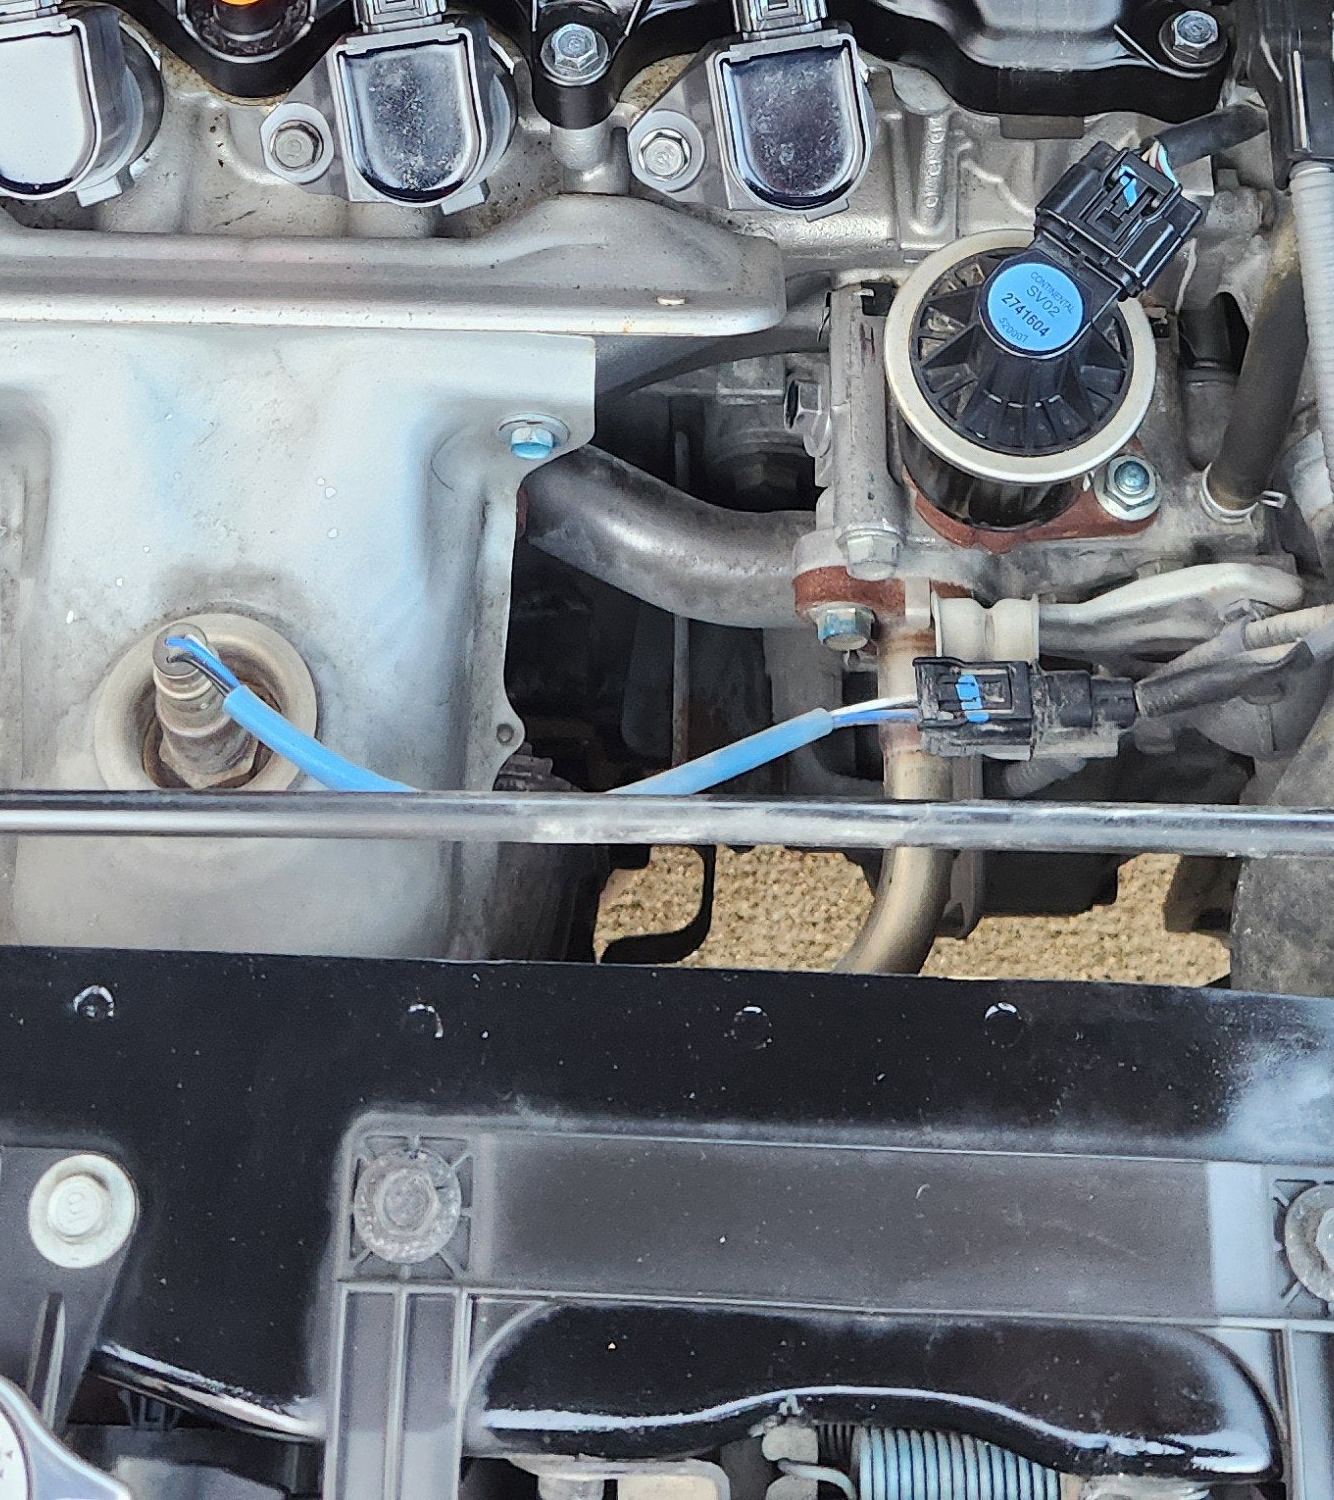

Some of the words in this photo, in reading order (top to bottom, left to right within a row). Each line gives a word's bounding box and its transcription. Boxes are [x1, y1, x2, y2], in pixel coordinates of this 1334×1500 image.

[1026, 285, 1060, 318] SV02
[1030, 271, 1075, 314] CONTINENTAL
[1001, 292, 1052, 337] 2741604
